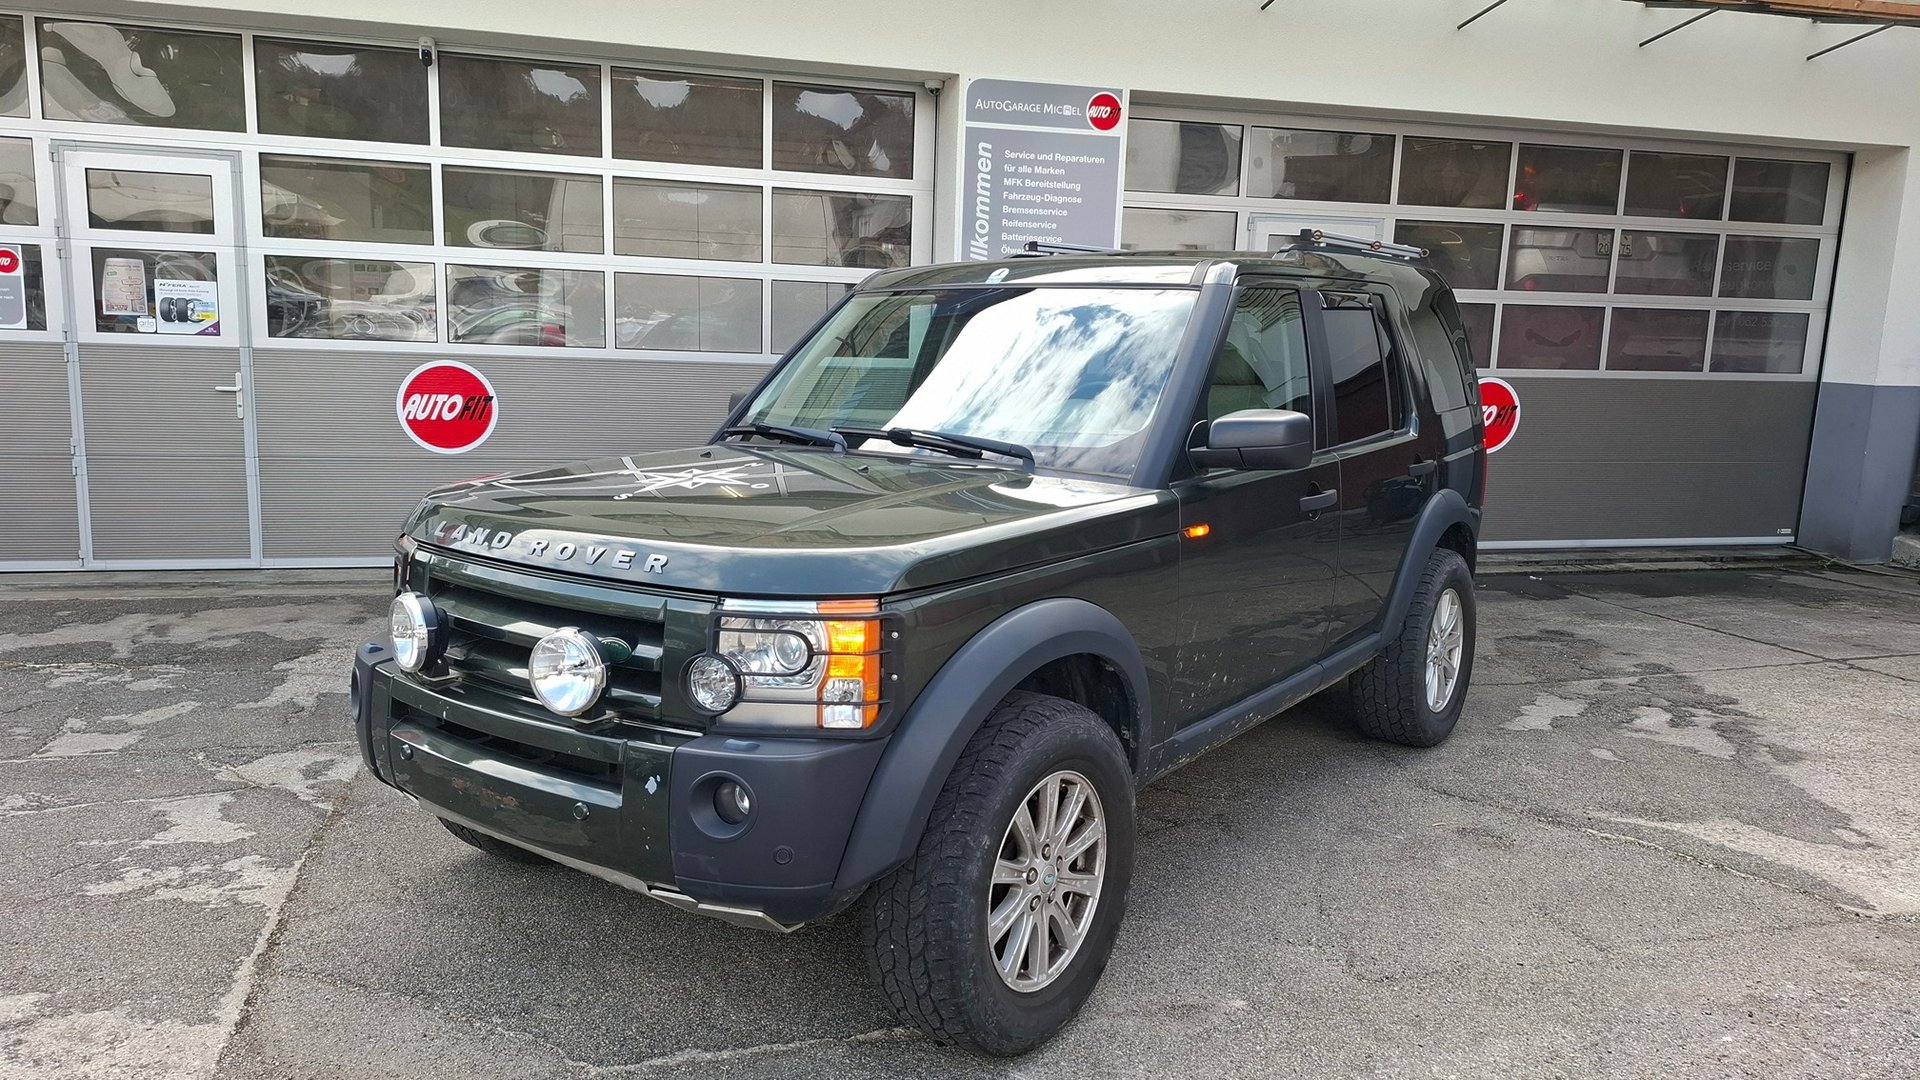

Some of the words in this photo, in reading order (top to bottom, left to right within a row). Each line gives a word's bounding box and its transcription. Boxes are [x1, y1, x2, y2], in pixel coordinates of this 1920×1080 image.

[1088, 105, 1122, 119] AUTOFIT
[1004, 150, 1036, 159] Service
[1037, 151, 1054, 161] und
[1055, 153, 1105, 164] Reparaturen
[1004, 164, 1016, 173] für
[1018, 165, 1032, 174] alle
[1034, 166, 1065, 175] Marken
[1003, 178, 1023, 187] MFK
[1025, 179, 1081, 191] Bereitstellung
[970, 141, 993, 261] llkommen
[1003, 191, 1082, 204] Fahrzeug-Diagnose
[1002, 205, 1068, 216] Bremsenservice
[1001, 219, 1057, 230] Reifenservice
[1001, 232, 1062, 243] Batterieservice
[403, 392, 494, 421] AUTOFIT
[1482, 405, 1518, 427] OFIT
[434, 520, 514, 549] LAND
[528, 539, 669, 574] ROVER
